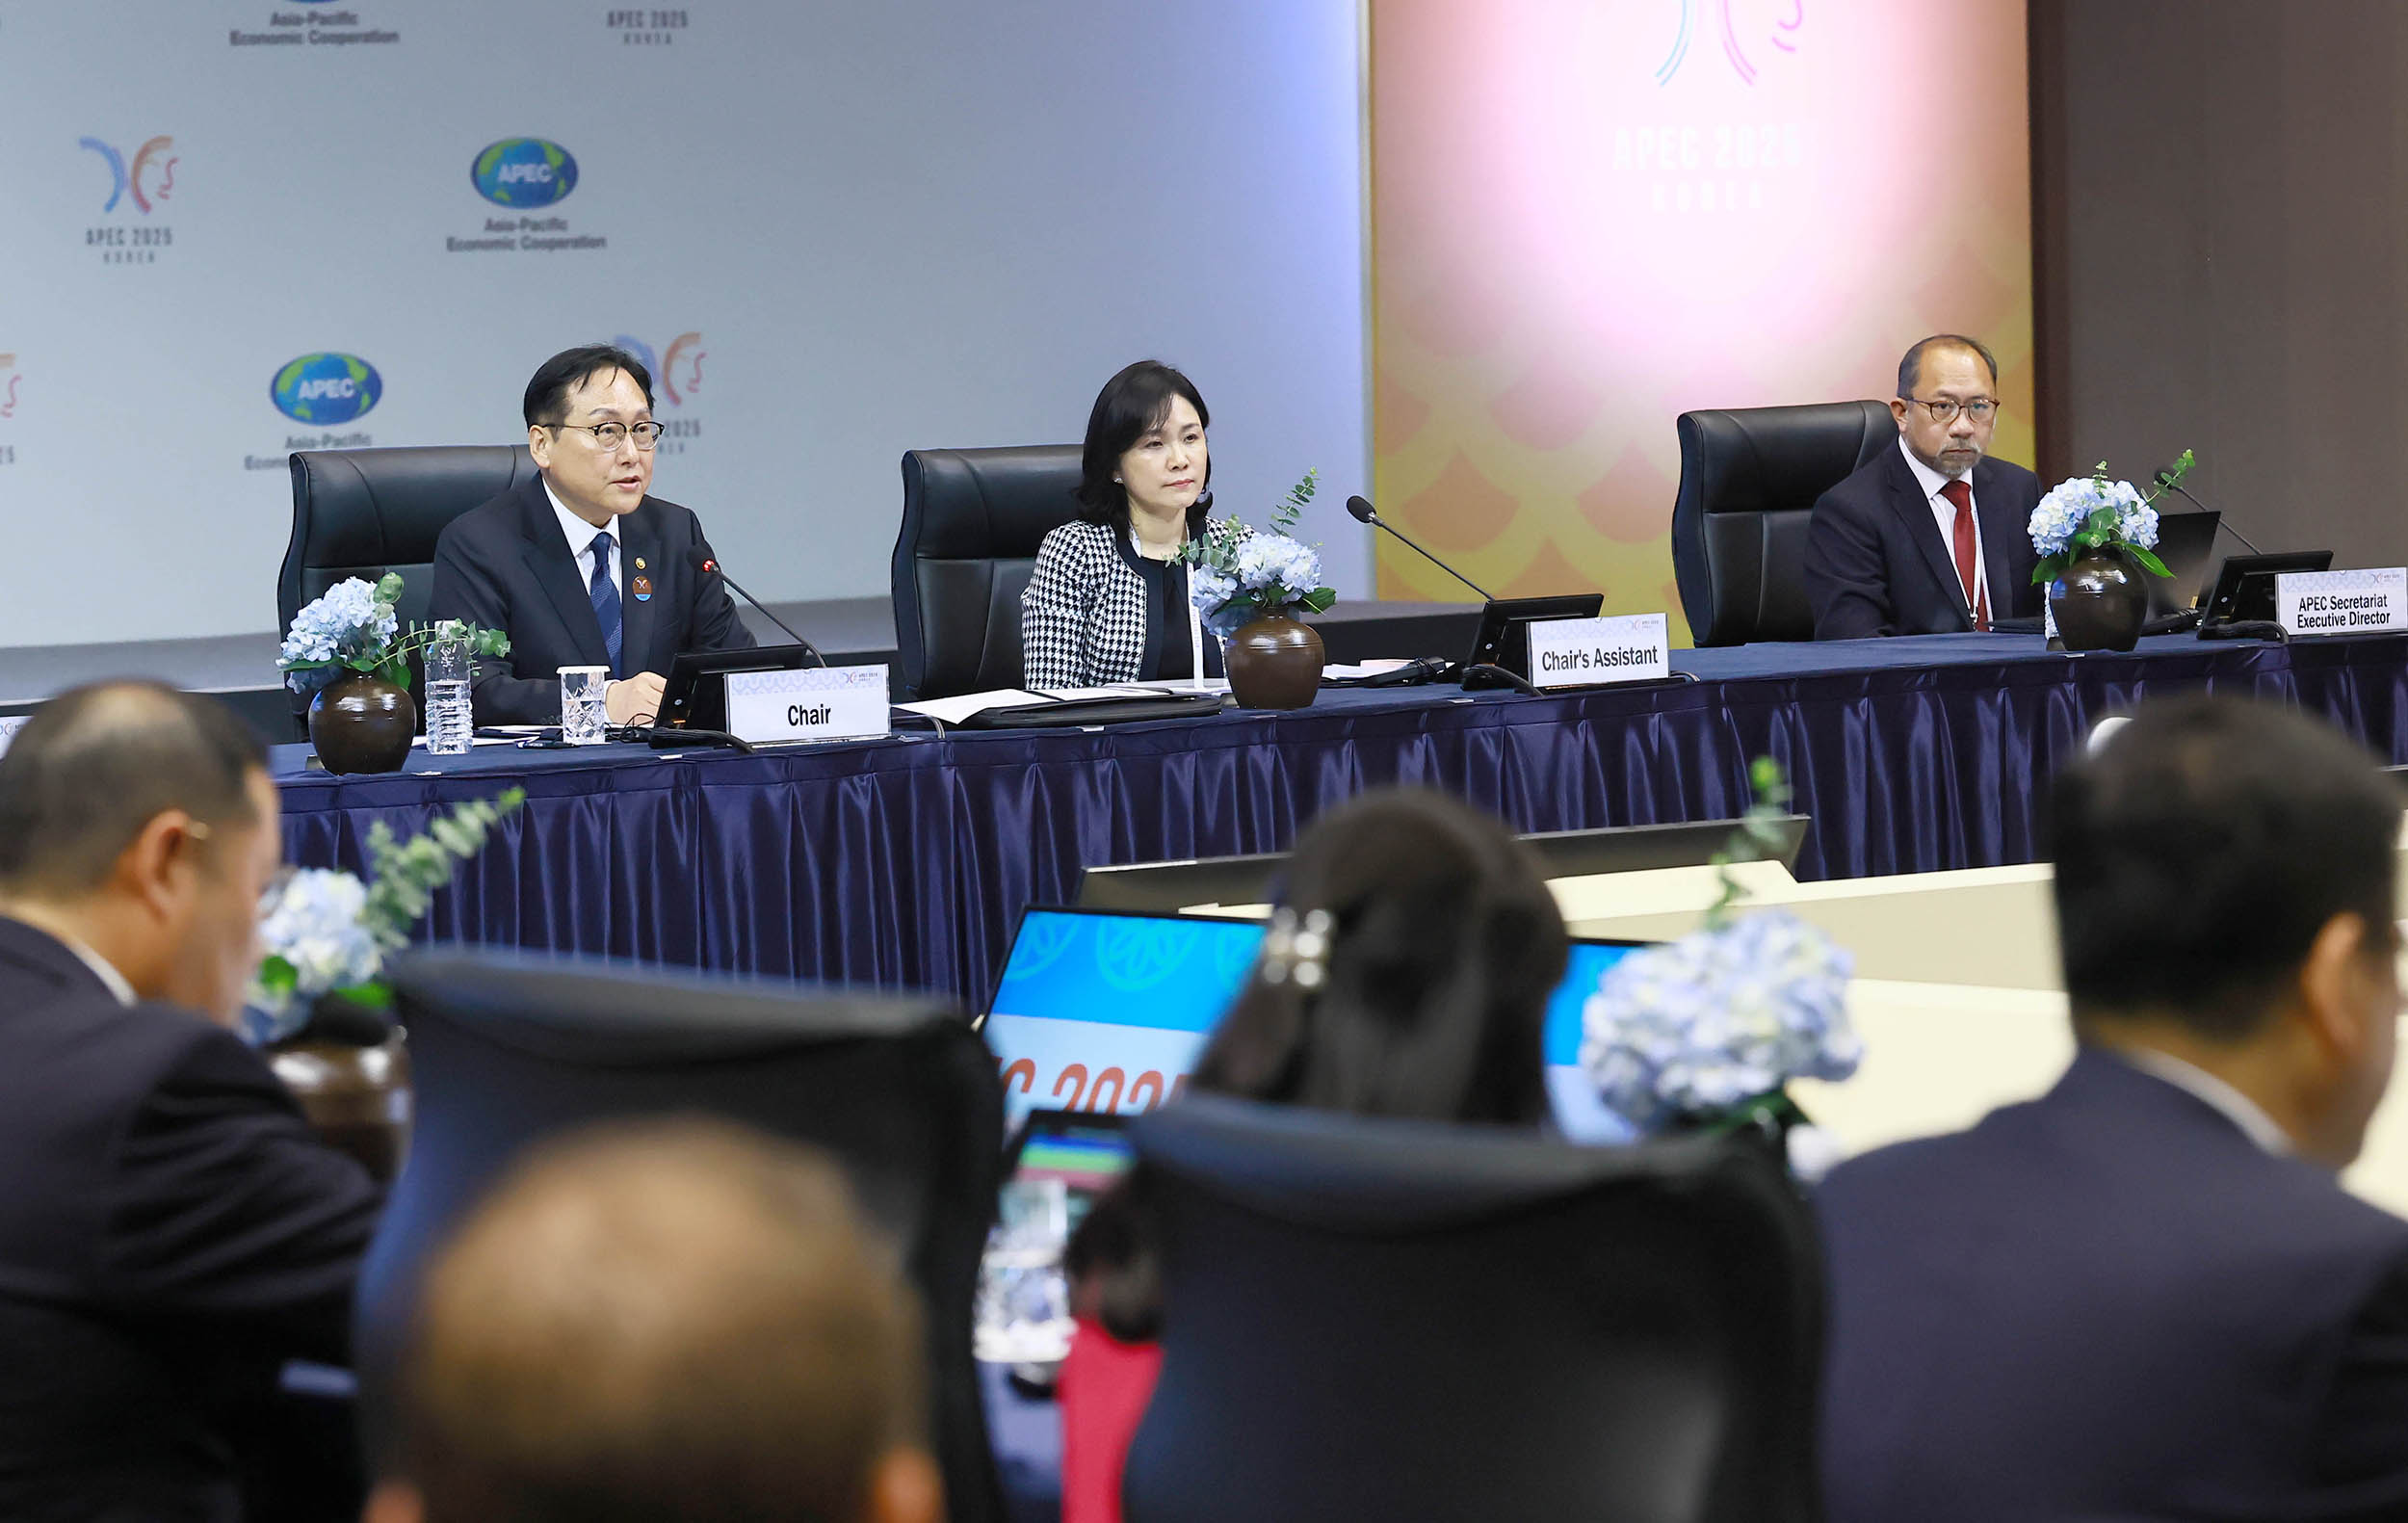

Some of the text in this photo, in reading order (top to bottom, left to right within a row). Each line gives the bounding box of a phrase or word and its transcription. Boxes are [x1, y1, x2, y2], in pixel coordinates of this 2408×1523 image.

[271, 12, 358, 26] Asia-Pacific
[230, 30, 399, 45] Economic Cooperation
[1612, 122, 1802, 170] APEC 2025
[498, 163, 553, 183] APEC
[484, 218, 568, 231] Asia-Pacific
[447, 235, 607, 251] Economic Cooperation
[299, 379, 355, 400] APEC
[285, 433, 372, 448] Asia-Pacific
[2299, 593, 2388, 612] APEC Secretariat
[2297, 611, 2391, 628] Executive Director
[1542, 645, 1659, 671] Chair's Assistant
[788, 703, 831, 726] Chair
